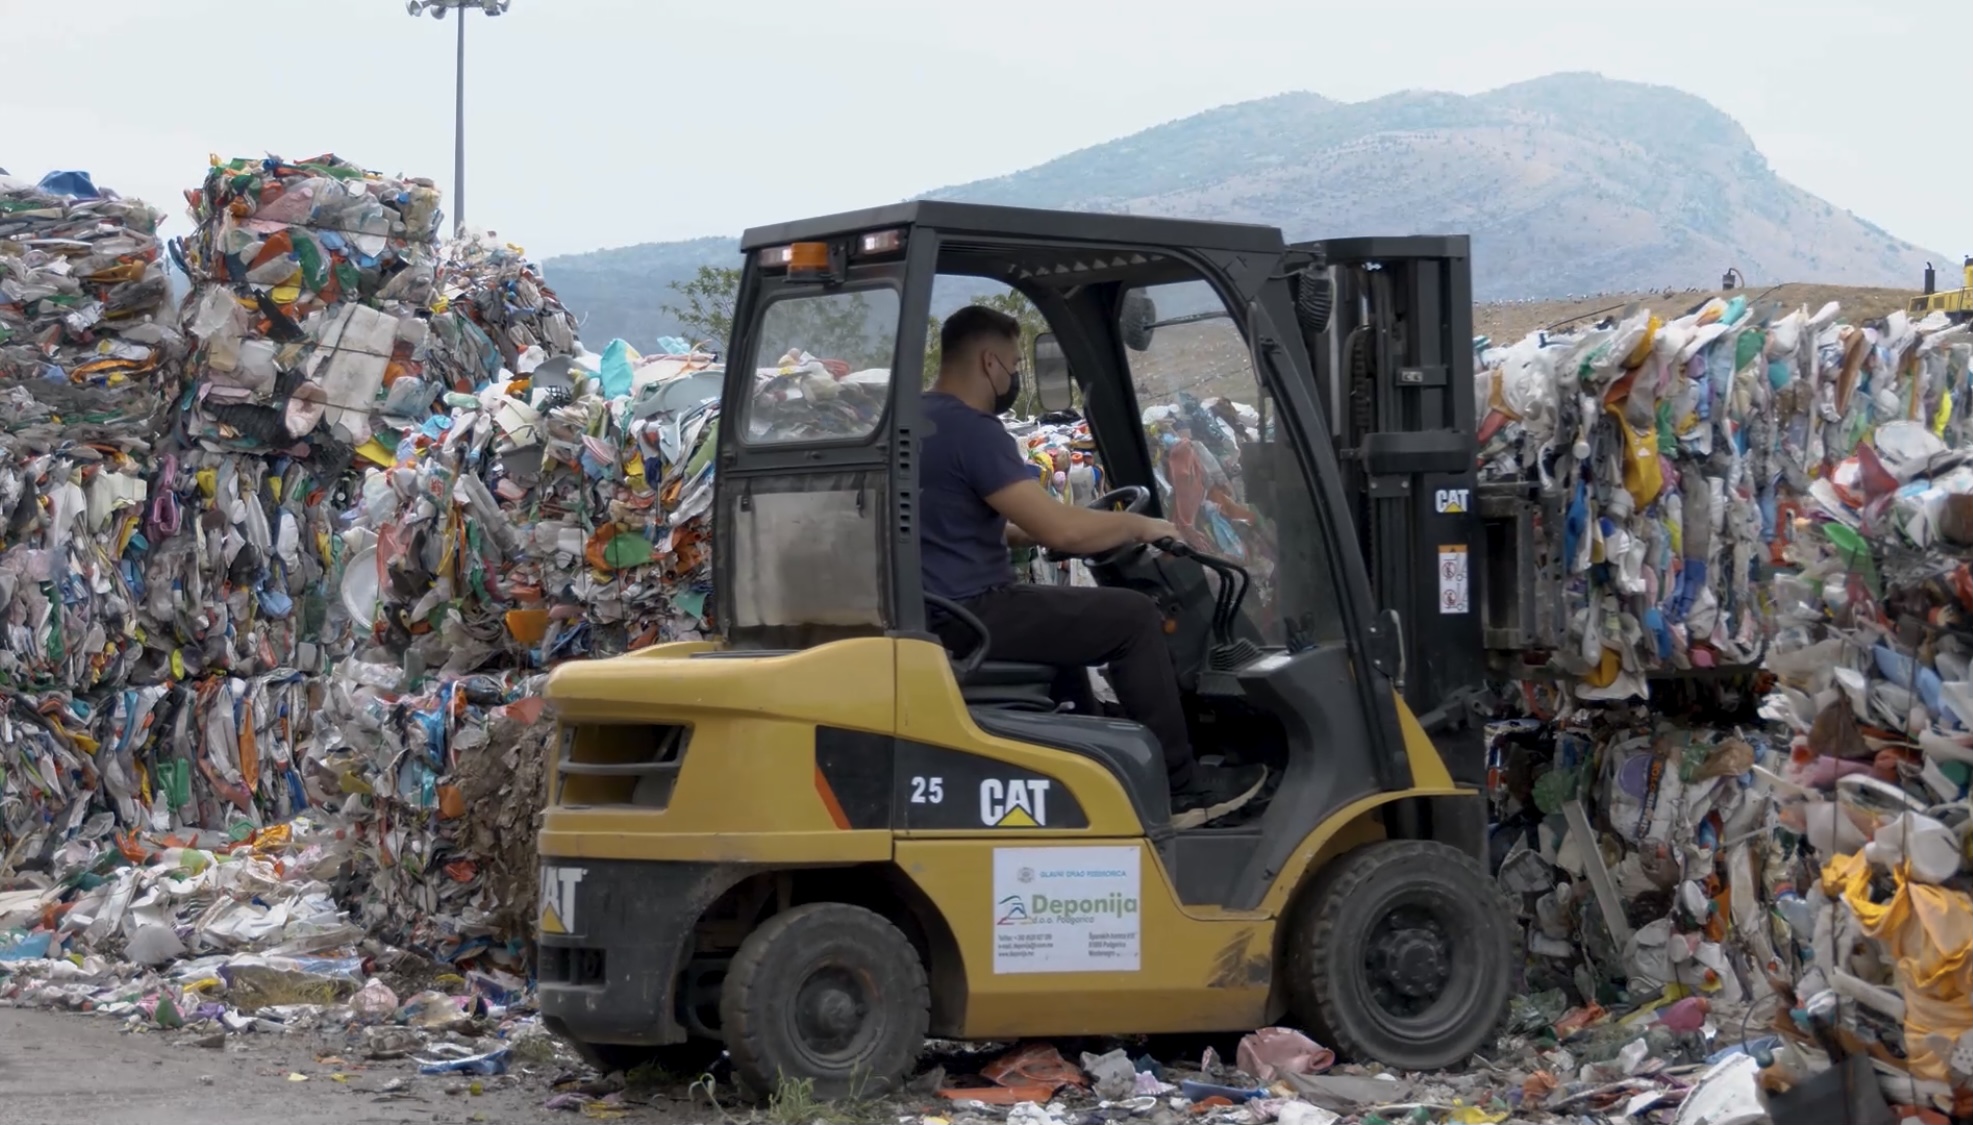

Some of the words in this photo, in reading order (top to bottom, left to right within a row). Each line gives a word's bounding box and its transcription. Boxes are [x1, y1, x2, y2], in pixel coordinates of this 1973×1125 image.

[1435, 489, 1469, 513] CAT
[910, 776, 944, 804] 25
[979, 778, 1050, 826] CAT
[540, 866, 583, 934] AT
[1031, 892, 1137, 919] Deponija
